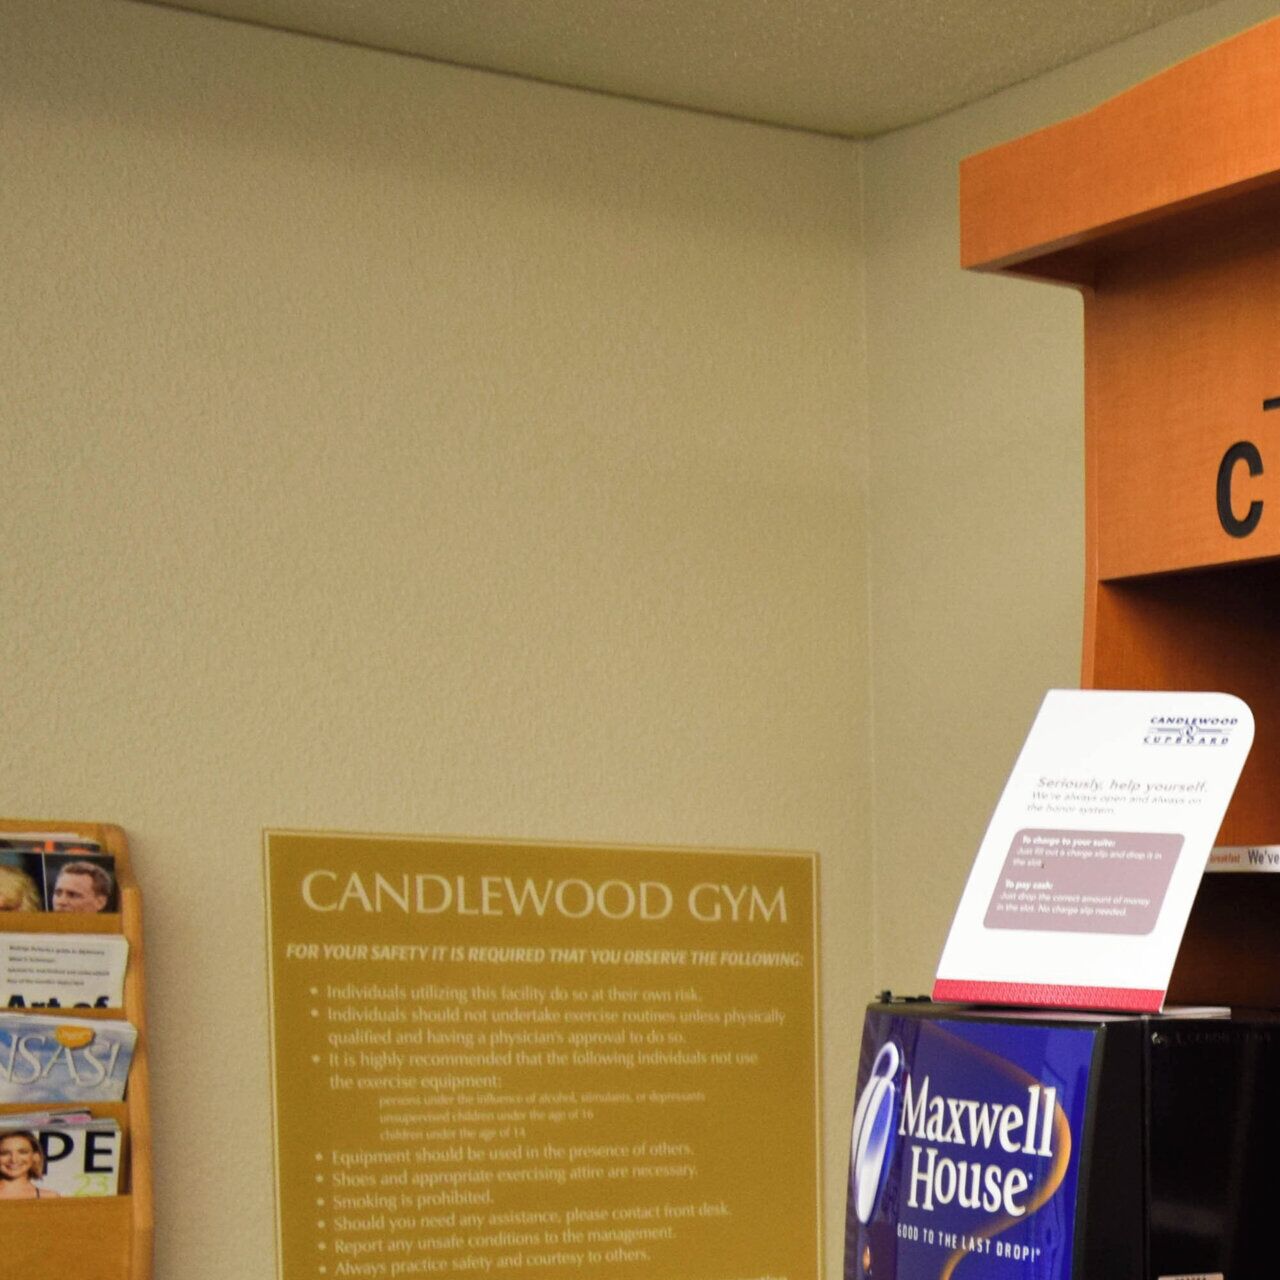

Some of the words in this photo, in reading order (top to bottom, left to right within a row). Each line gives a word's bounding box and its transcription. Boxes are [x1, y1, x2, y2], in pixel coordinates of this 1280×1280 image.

[1151, 717, 1238, 725] CANDLEWOOD
[1038, 777, 1103, 792] Seriously,
[1110, 778, 1141, 792] help
[1146, 780, 1207, 793] yourself.
[1248, 849, 1280, 865] We've
[302, 868, 673, 921] CANDLEWOOD
[688, 884, 788, 924] GYM
[286, 944, 319, 960] FOR
[323, 944, 367, 960] YOUR
[371, 945, 426, 961] SAFETY
[431, 946, 447, 961] IT
[450, 946, 465, 961] IS
[468, 946, 545, 963] REQUIRED
[551, 949, 586, 963] THAT
[591, 950, 621, 965] YOU
[624, 950, 687, 965] OBSERVE
[691, 951, 717, 966] THE
[326, 985, 407, 1000] Individuals
[411, 985, 468, 1003] utilizing
[471, 986, 496, 1000] this
[501, 986, 545, 1003] facility
[551, 986, 568, 1001] do
[572, 990, 588, 1001] so
[592, 989, 606, 1001] at
[608, 987, 637, 1001] their
[642, 990, 671, 1002] own
[898, 1073, 1056, 1157] Maxwell
[333, 1173, 376, 1187] Shoes
[381, 1171, 407, 1185] and
[412, 1169, 493, 1188] appropriate
[497, 1168, 567, 1184] exercising
[570, 1165, 604, 1179] attire
[608, 1167, 628, 1178] are
[908, 1145, 1028, 1217] House
[333, 1195, 397, 1211] Smoking
[401, 1194, 413, 1205] is
[897, 1223, 918, 1240] GOOD
[923, 1229, 934, 1244] TO
[939, 1232, 957, 1249] THE
[962, 1235, 991, 1253] LAST
